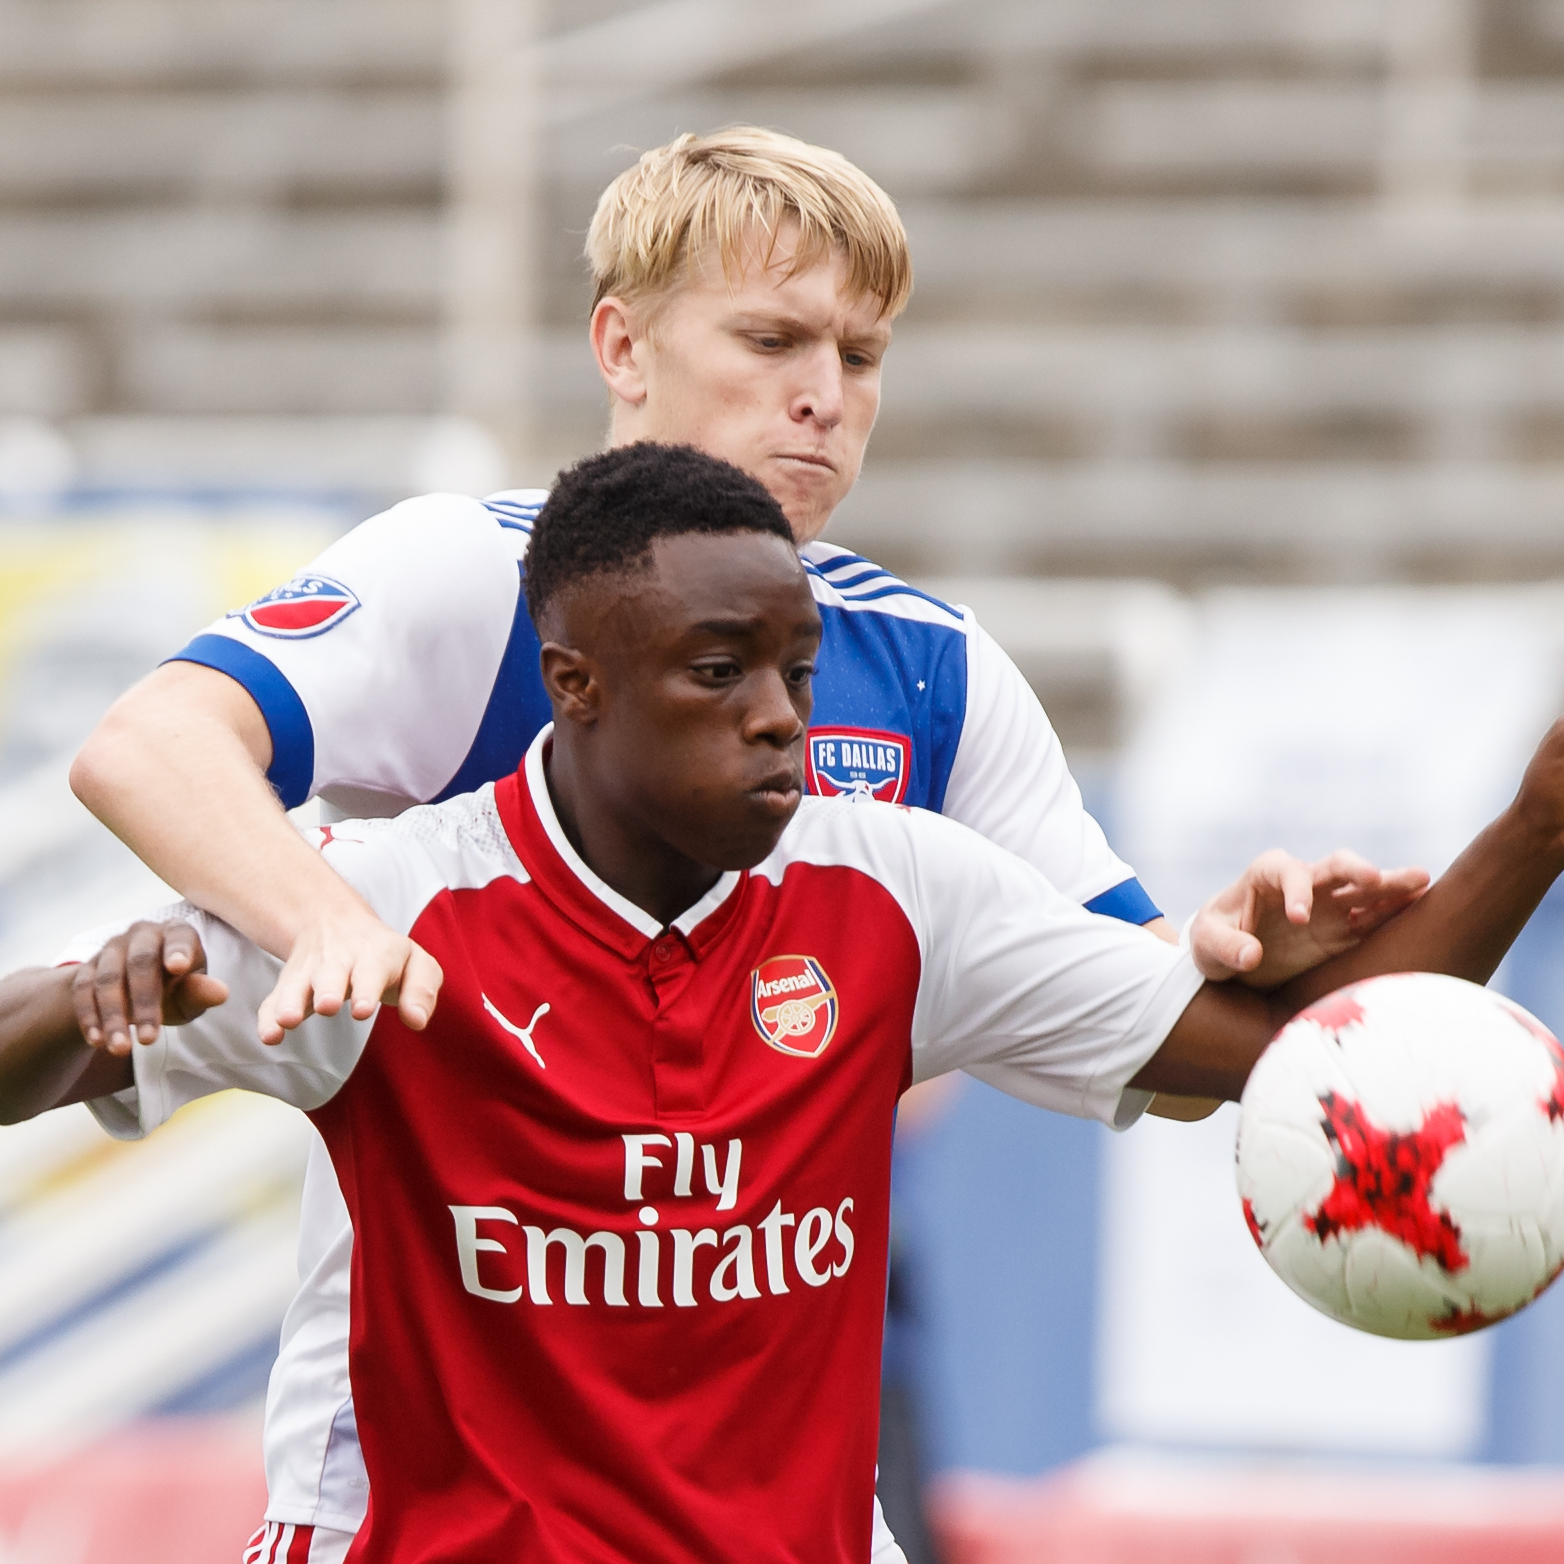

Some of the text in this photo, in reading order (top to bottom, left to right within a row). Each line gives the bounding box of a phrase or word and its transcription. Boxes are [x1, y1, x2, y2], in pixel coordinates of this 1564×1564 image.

[818, 742, 896, 772] FC DALLAS
[757, 969, 817, 998] Arsenal
[621, 1132, 742, 1211] Fly
[447, 1197, 854, 1307] Emirates
